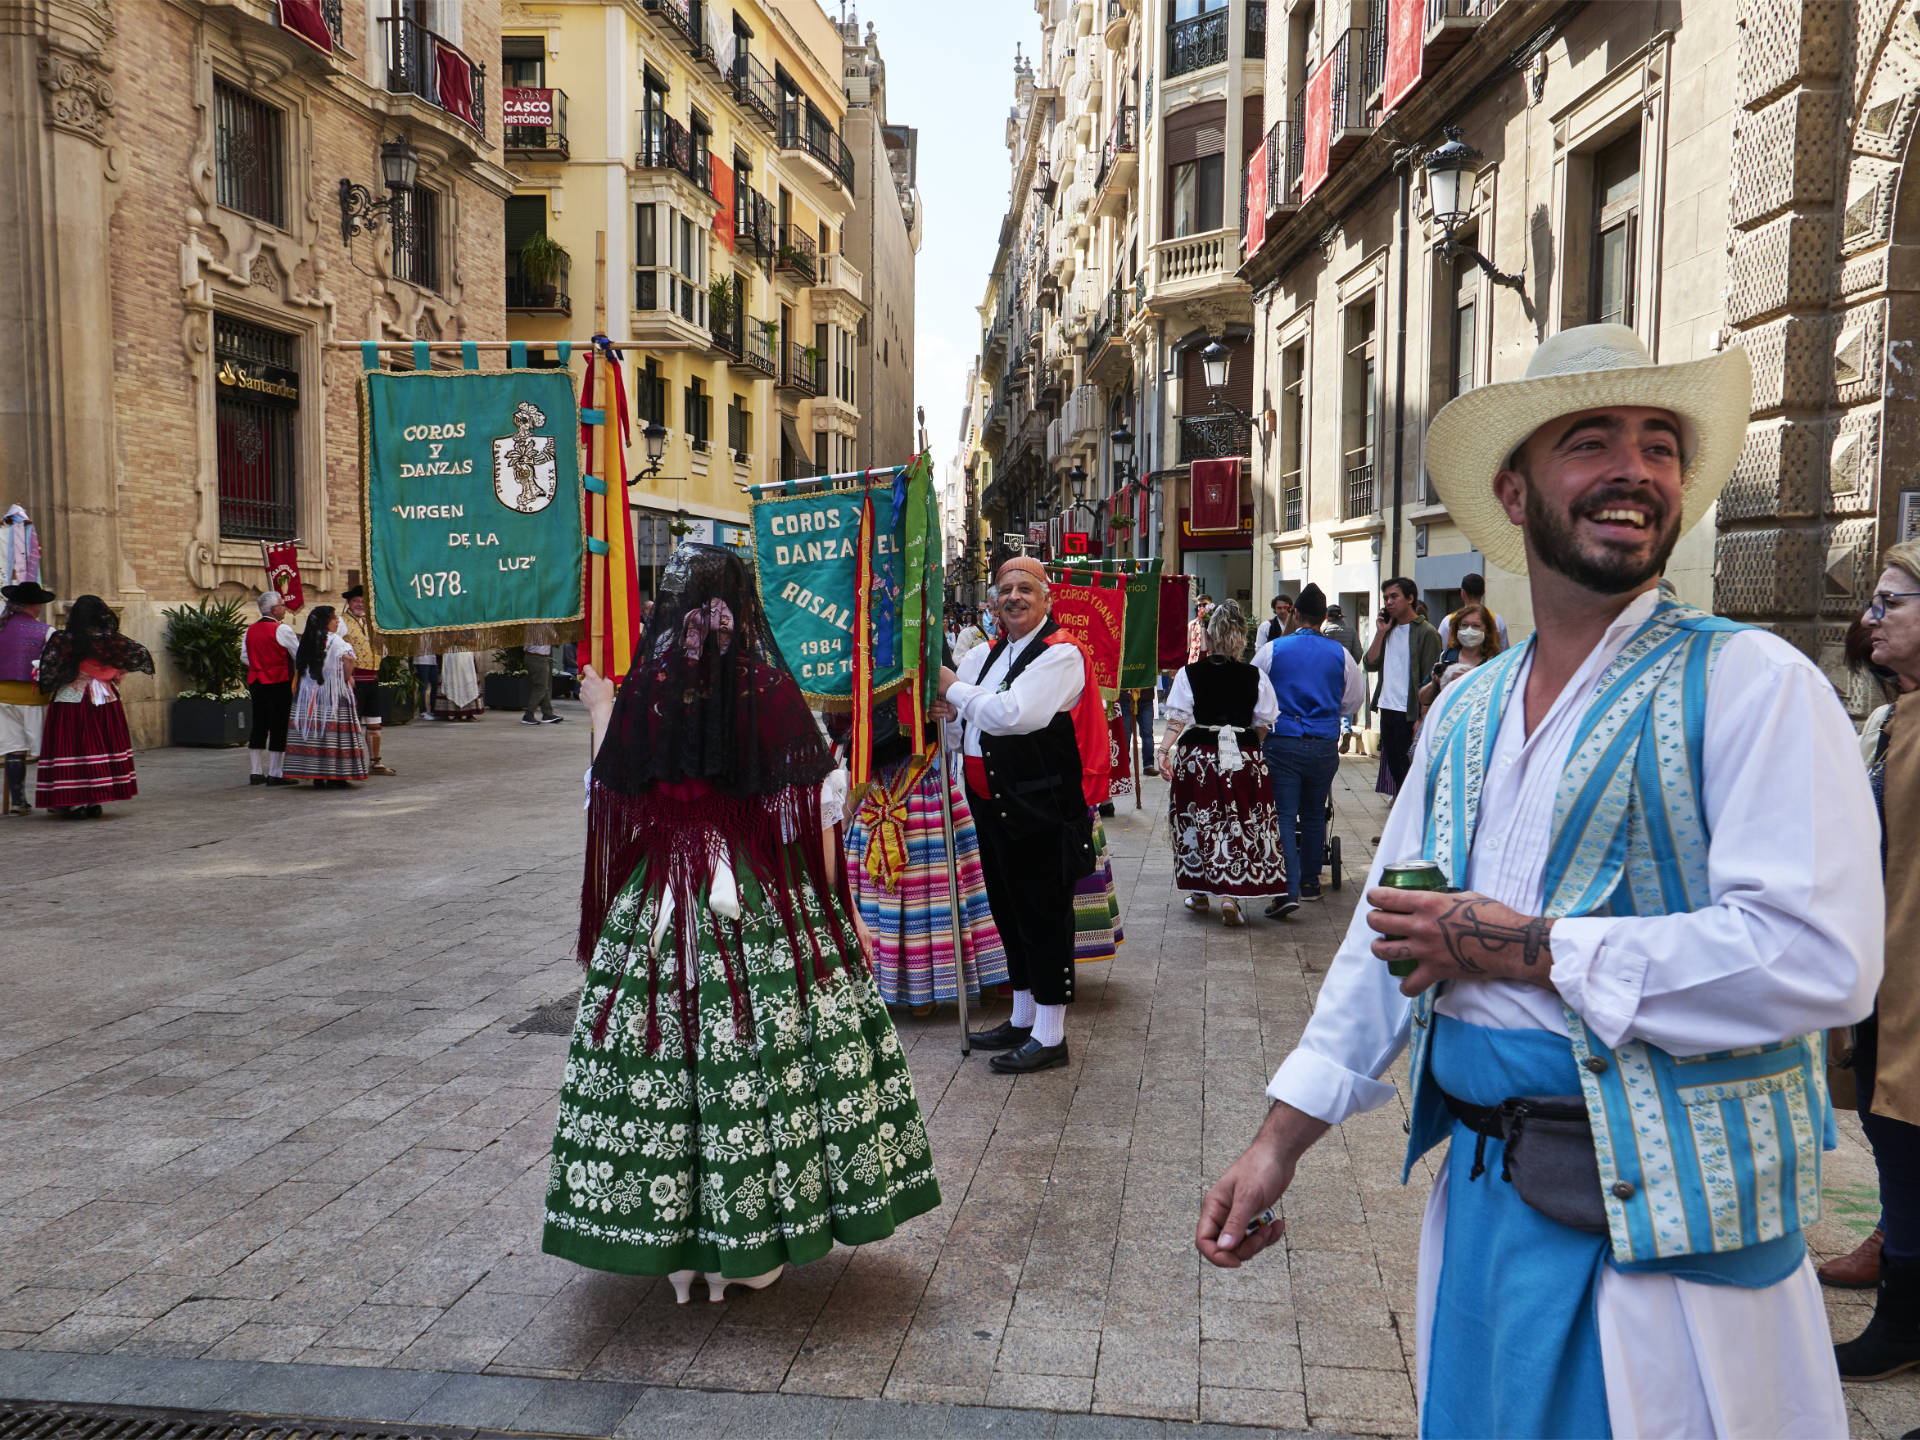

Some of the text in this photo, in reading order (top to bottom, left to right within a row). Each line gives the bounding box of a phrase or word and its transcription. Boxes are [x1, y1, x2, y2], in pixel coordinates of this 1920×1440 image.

[504, 101, 550, 113] CASCO
[504, 113, 552, 125] HISTÓRICO
[238, 369, 297, 400] Santander
[404, 422, 466, 441] COROS
[429, 444, 443, 458] Y
[400, 459, 473, 478] DANZAS
[771, 508, 840, 536] COROS
[448, 533, 499, 547] DE LA
[1058, 612, 1090, 627] VIRGEN
[1060, 589, 1090, 601] COROS
[1090, 594, 1098, 606] Y
[1094, 599, 1121, 640] DANZAS
[801, 639, 841, 655] 1984
